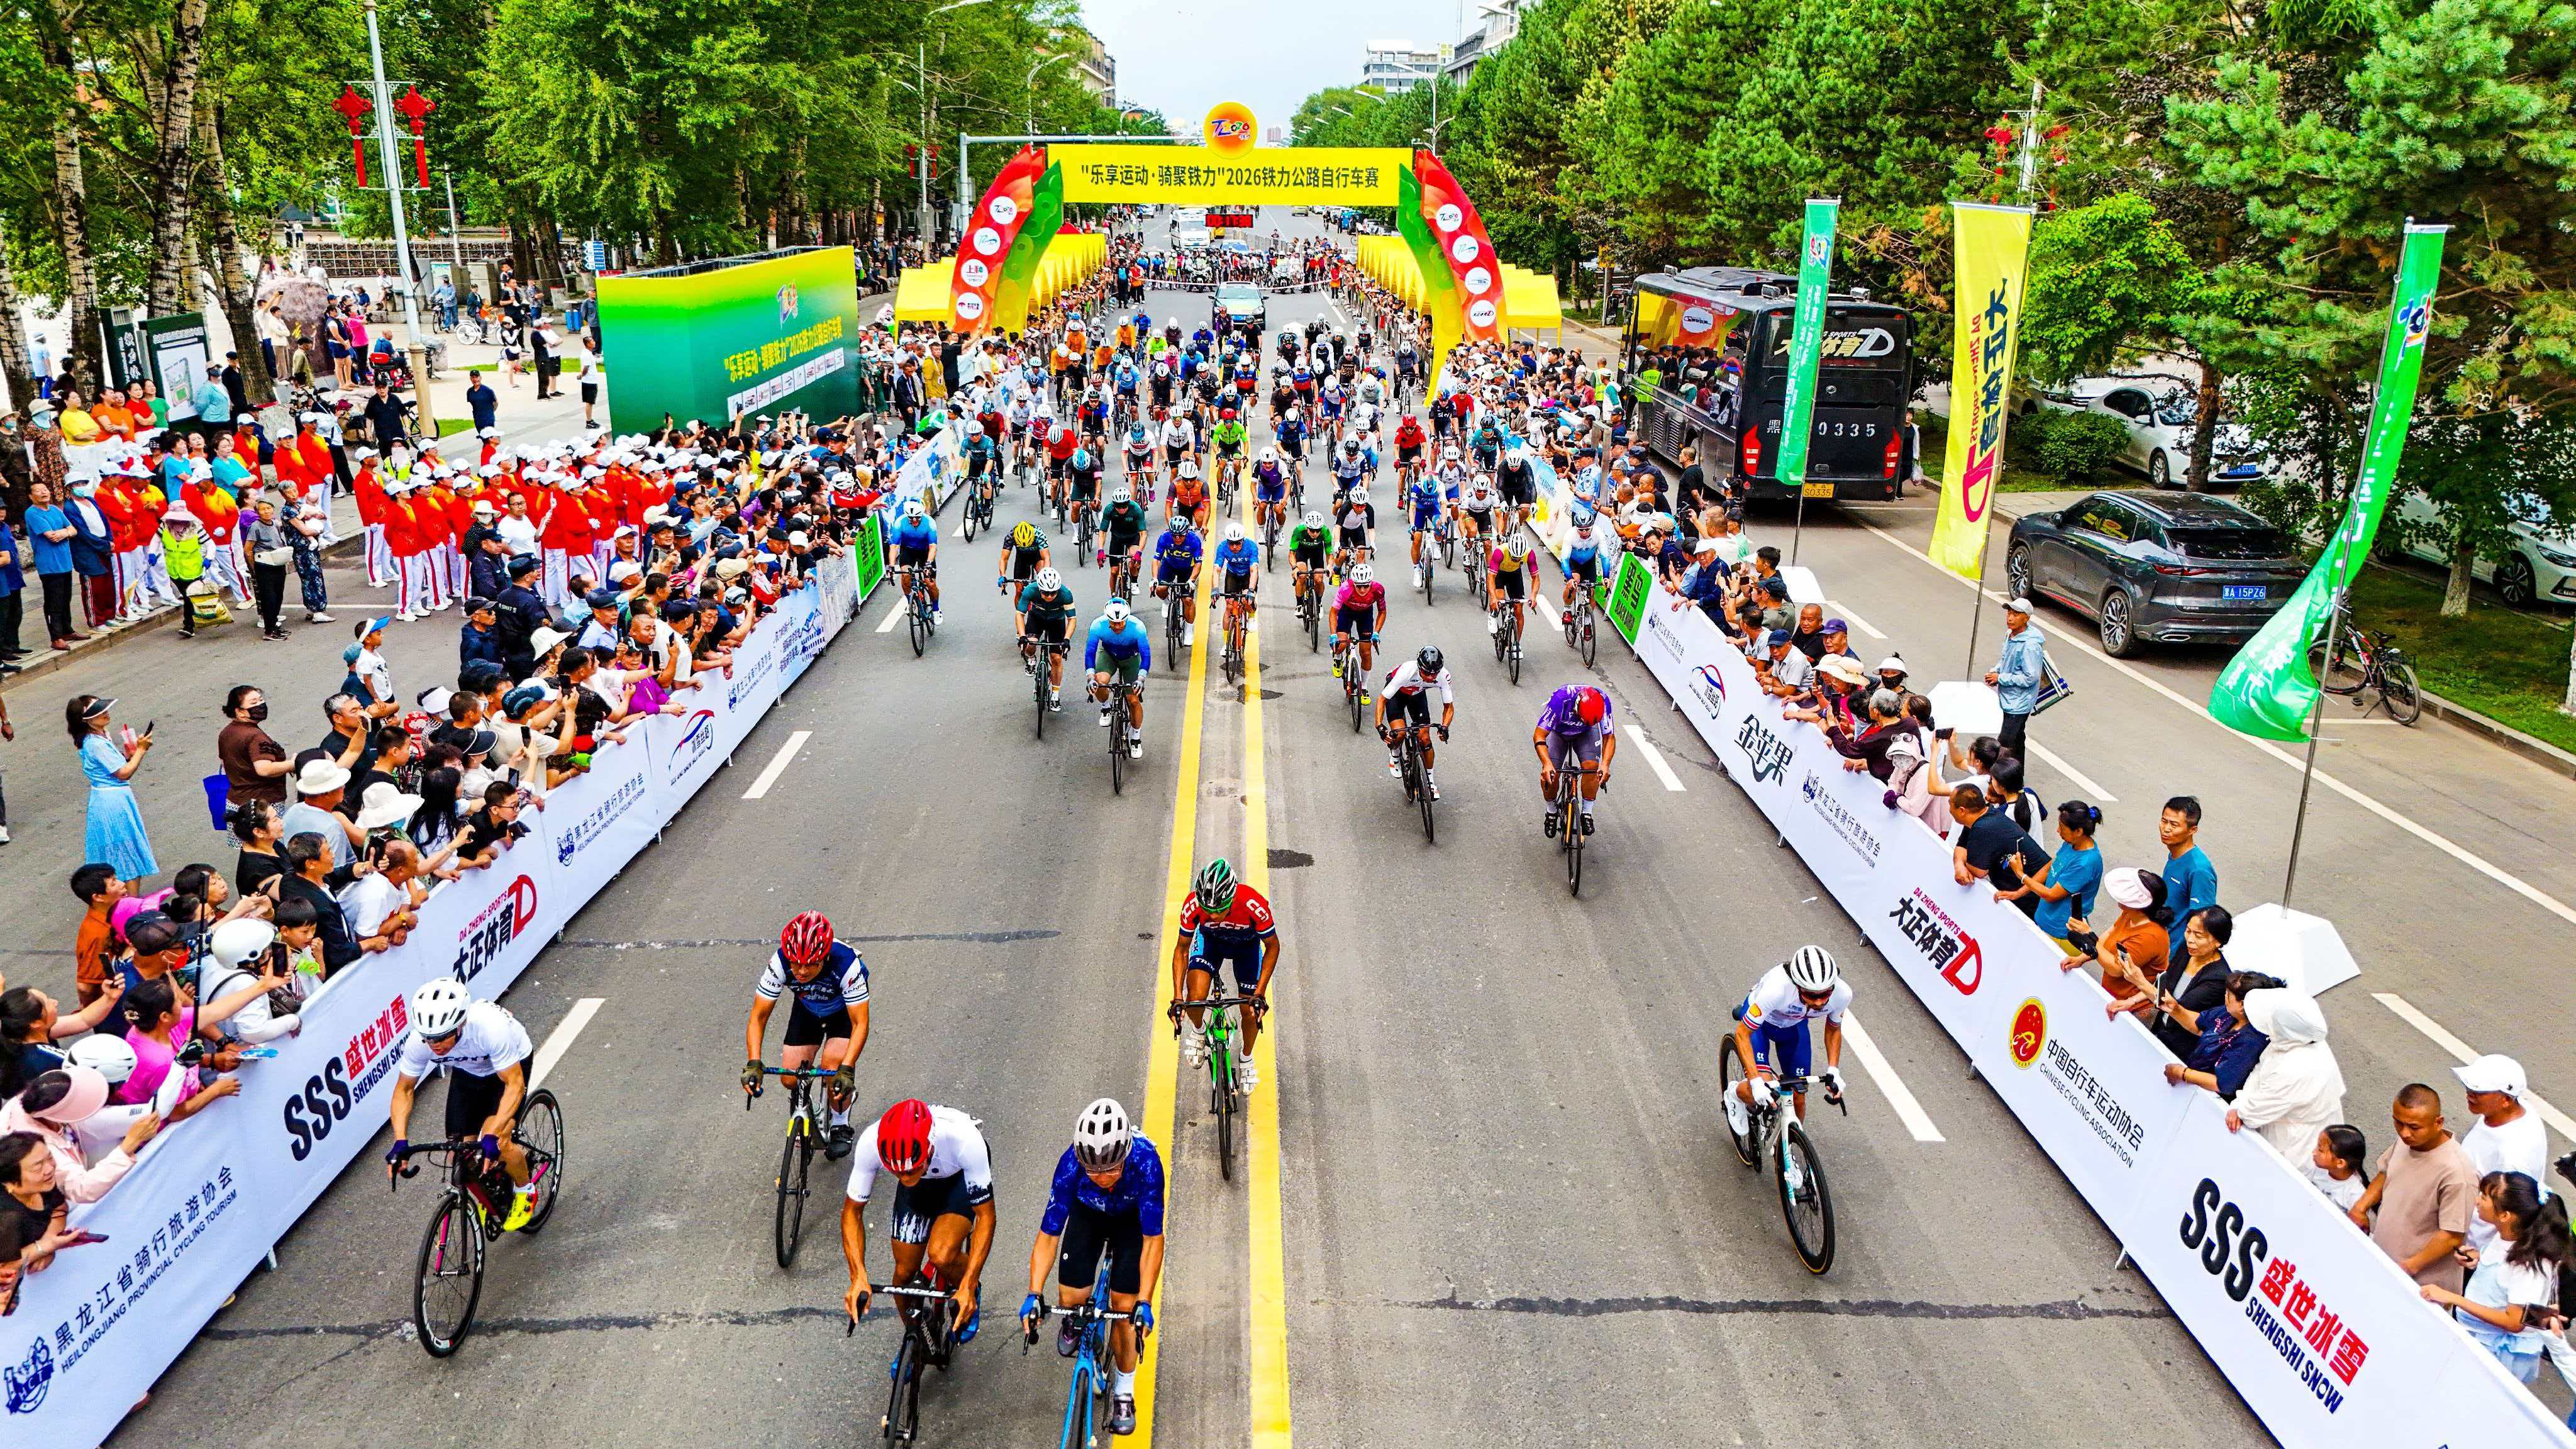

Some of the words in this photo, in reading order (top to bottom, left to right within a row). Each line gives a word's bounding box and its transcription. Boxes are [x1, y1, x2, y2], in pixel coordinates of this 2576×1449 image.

[1080, 164, 1379, 189] "乐享运动·骑聚铁力"2026铁力公路自行车赛
[1733, 714, 1793, 787] 金苹果
[452, 899, 514, 986] 大正体育
[458, 928, 467, 943] DA
[468, 910, 487, 936] ZHENG
[487, 890, 508, 921] SPORTS
[1889, 897, 1958, 970] 大正体育
[1913, 887, 1923, 900] DA
[1922, 893, 1940, 917] ZHENG
[1938, 911, 1962, 935] SPORTS
[345, 993, 408, 1080] 盛世冰雪
[284, 1057, 352, 1162] SSS
[352, 1057, 391, 1104] SHENGSHI
[2040, 1063, 2065, 1094] CHINESE
[2064, 1089, 2090, 1121] CYCLING
[2089, 1118, 2134, 1169] ASSOCIATION
[2047, 1038, 2144, 1151] 中国自行车运动协会
[55, 1166, 233, 1355] 黑龙江省骑行旅游协会
[61, 1304, 128, 1373] HEILONGJIANG
[128, 1257, 173, 1307] PROVINCIAL
[173, 1224, 206, 1258] CYCLING
[205, 1188, 238, 1226] TOURISM
[2179, 1177, 2268, 1302] SSS
[882, 1286, 946, 1297] PARDUS
[2259, 1256, 2370, 1386] 盛世冰雪
[919, 1319, 937, 1355] PARDUS
[2245, 1297, 2305, 1373] SHENGSHI
[2301, 1360, 2344, 1415] SNOW
